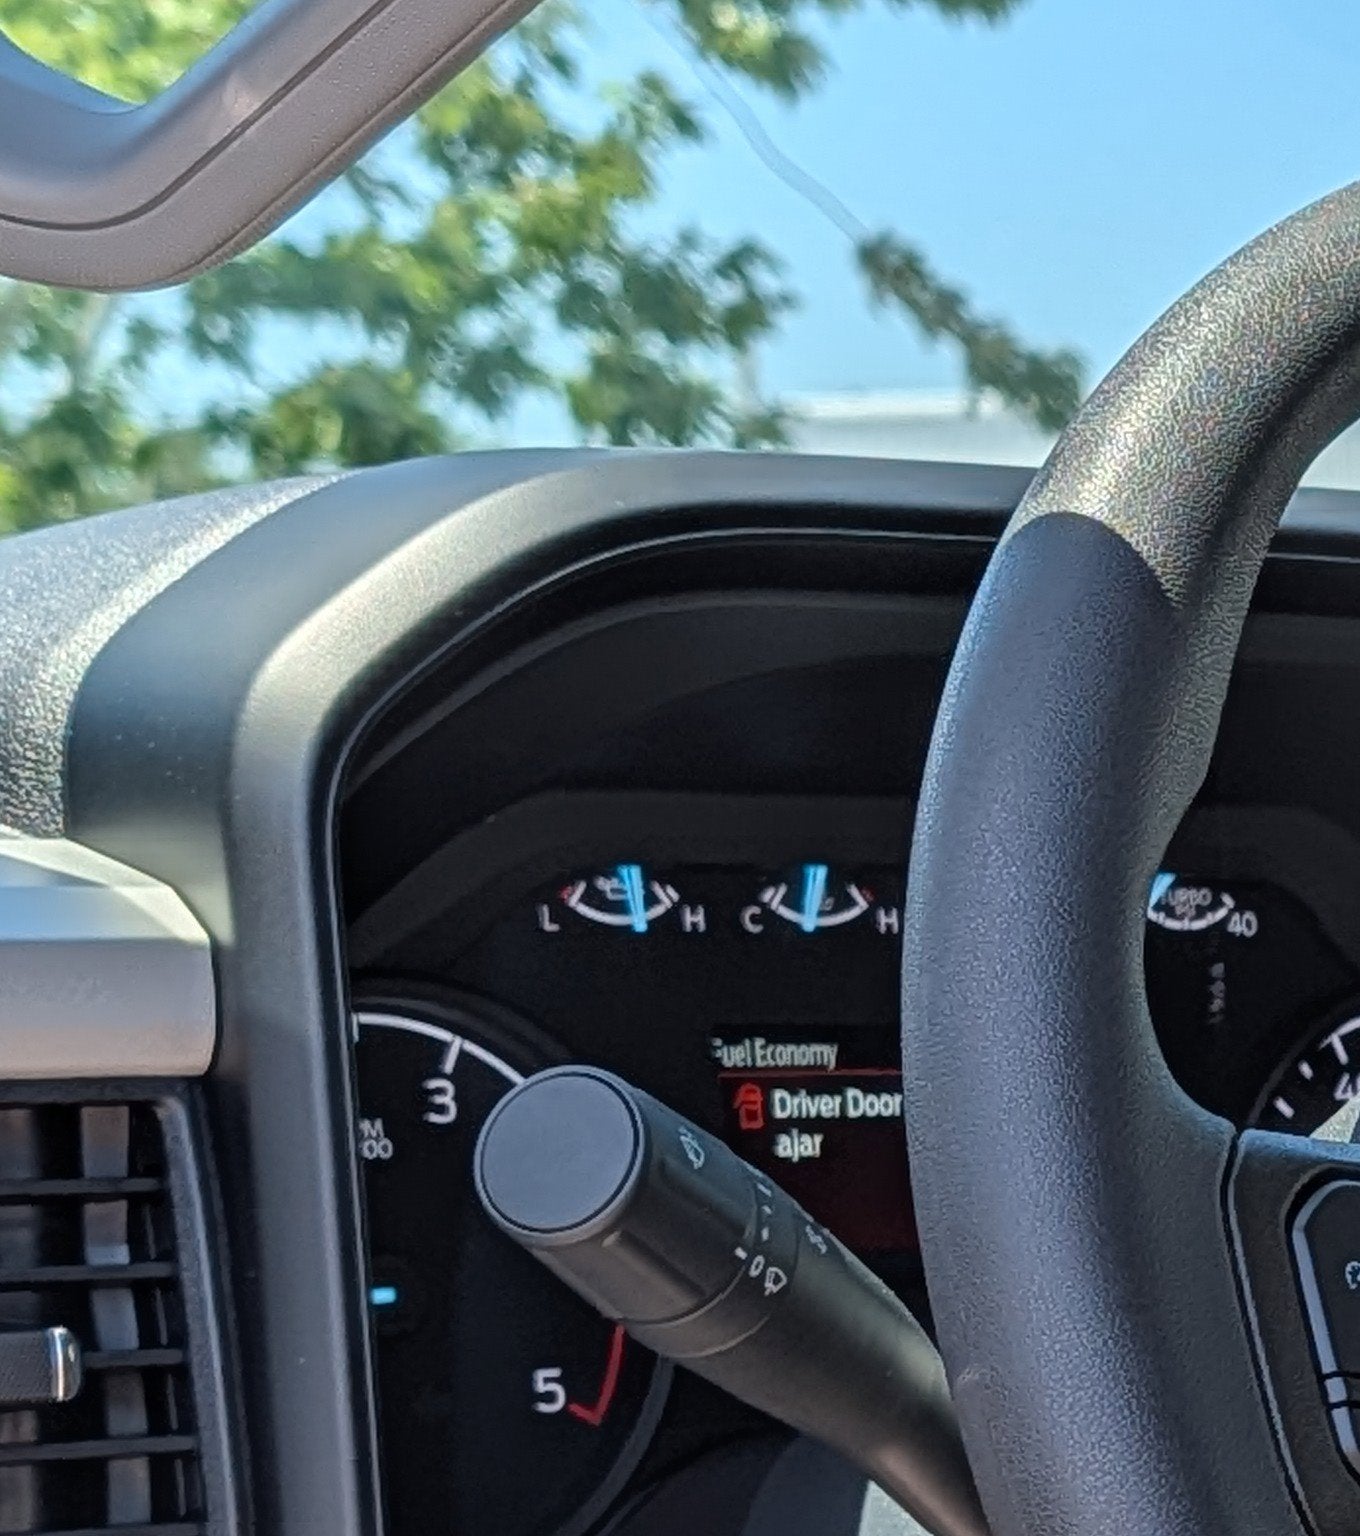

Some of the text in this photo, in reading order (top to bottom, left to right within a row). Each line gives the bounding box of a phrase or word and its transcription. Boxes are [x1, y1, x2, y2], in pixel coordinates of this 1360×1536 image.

[540, 906, 560, 932] L
[683, 909, 706, 932] H
[741, 908, 764, 934] C
[876, 909, 900, 934] H
[1227, 911, 1258, 937] 40
[712, 1036, 839, 1071] Fuel Economy
[422, 1077, 457, 1124] 3
[772, 1086, 903, 1120] Driver Door
[775, 1128, 825, 1164] ajar
[532, 1366, 566, 1413] 5
